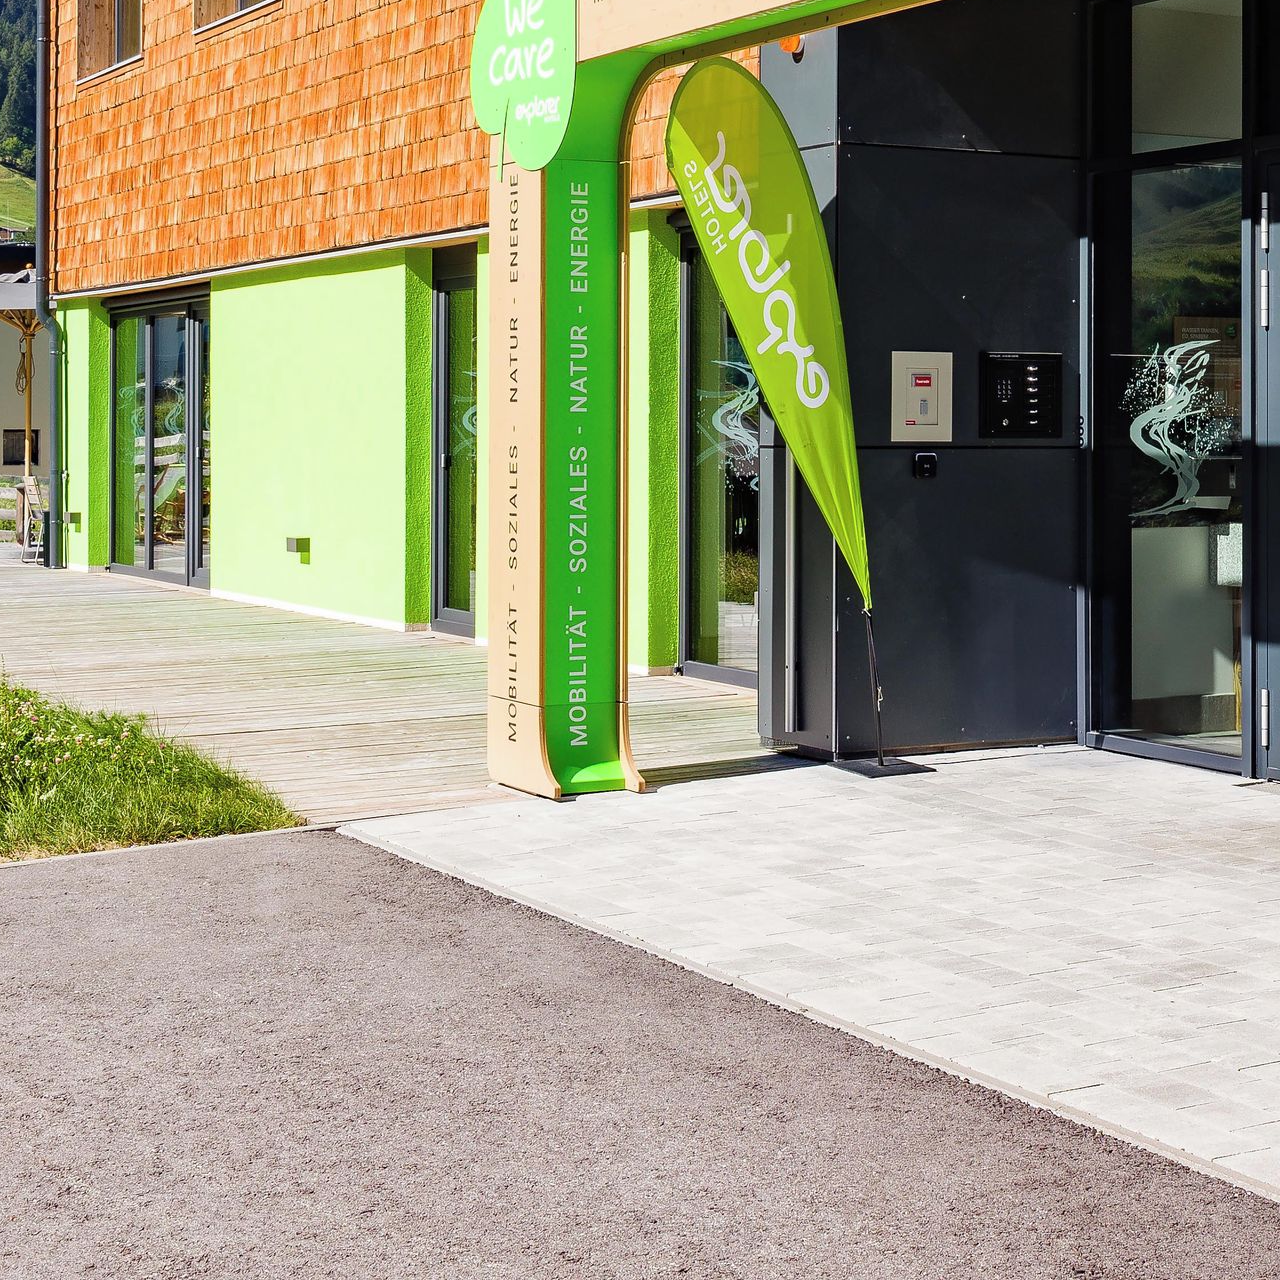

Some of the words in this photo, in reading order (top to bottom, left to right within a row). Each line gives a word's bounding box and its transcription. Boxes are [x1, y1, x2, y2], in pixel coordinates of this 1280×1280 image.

[489, 37, 555, 86] care
[509, 173, 519, 283] ENERGIE
[570, 182, 589, 293] ENERGIE
[509, 318, 519, 403] NATUR
[570, 324, 588, 413] NATUR
[509, 444, 518, 570] SOZIALES
[569, 445, 588, 573] SOZIALES
[507, 602, 518, 743] MOBILITÄT
[565, 605, 588, 746] MOBILITÄT
